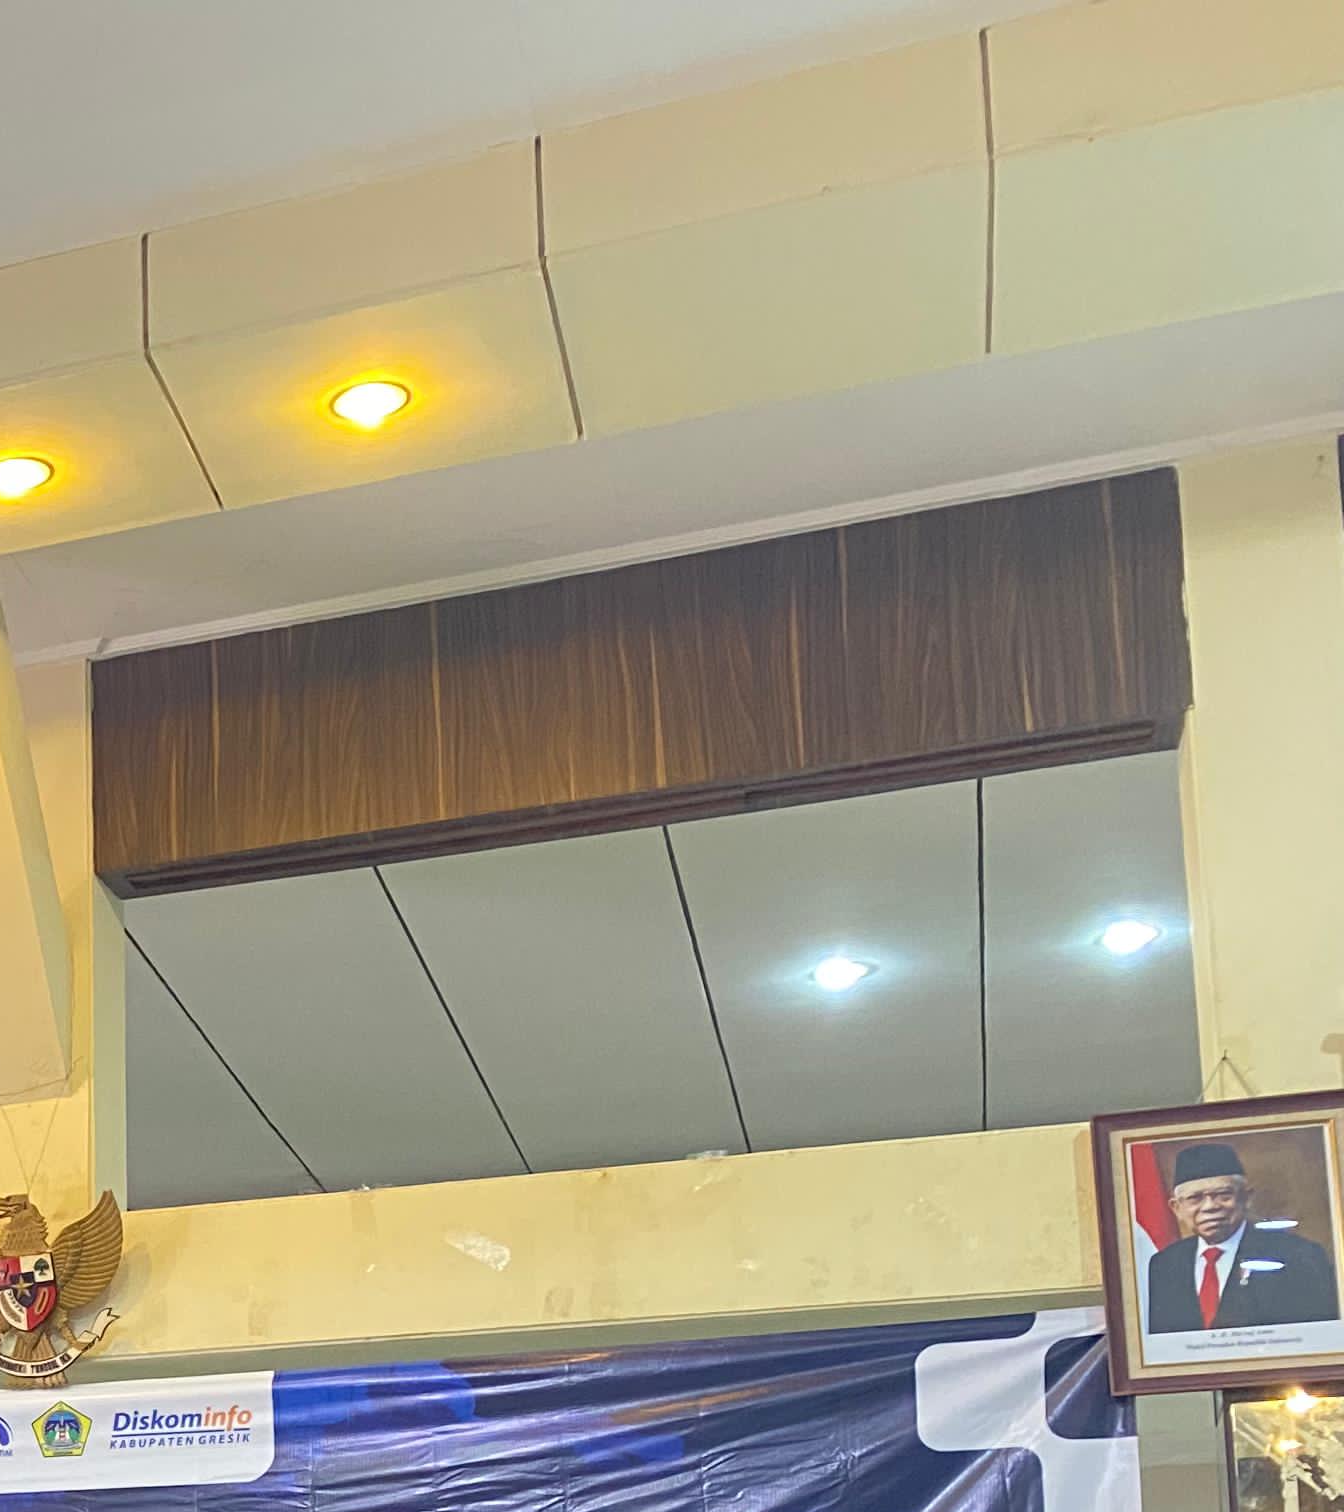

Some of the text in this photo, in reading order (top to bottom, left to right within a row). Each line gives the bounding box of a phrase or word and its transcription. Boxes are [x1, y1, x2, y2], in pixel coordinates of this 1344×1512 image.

[112, 1405, 253, 1432] Diskominfo
[110, 1433, 250, 1450] KABUPATEN GRESIK
